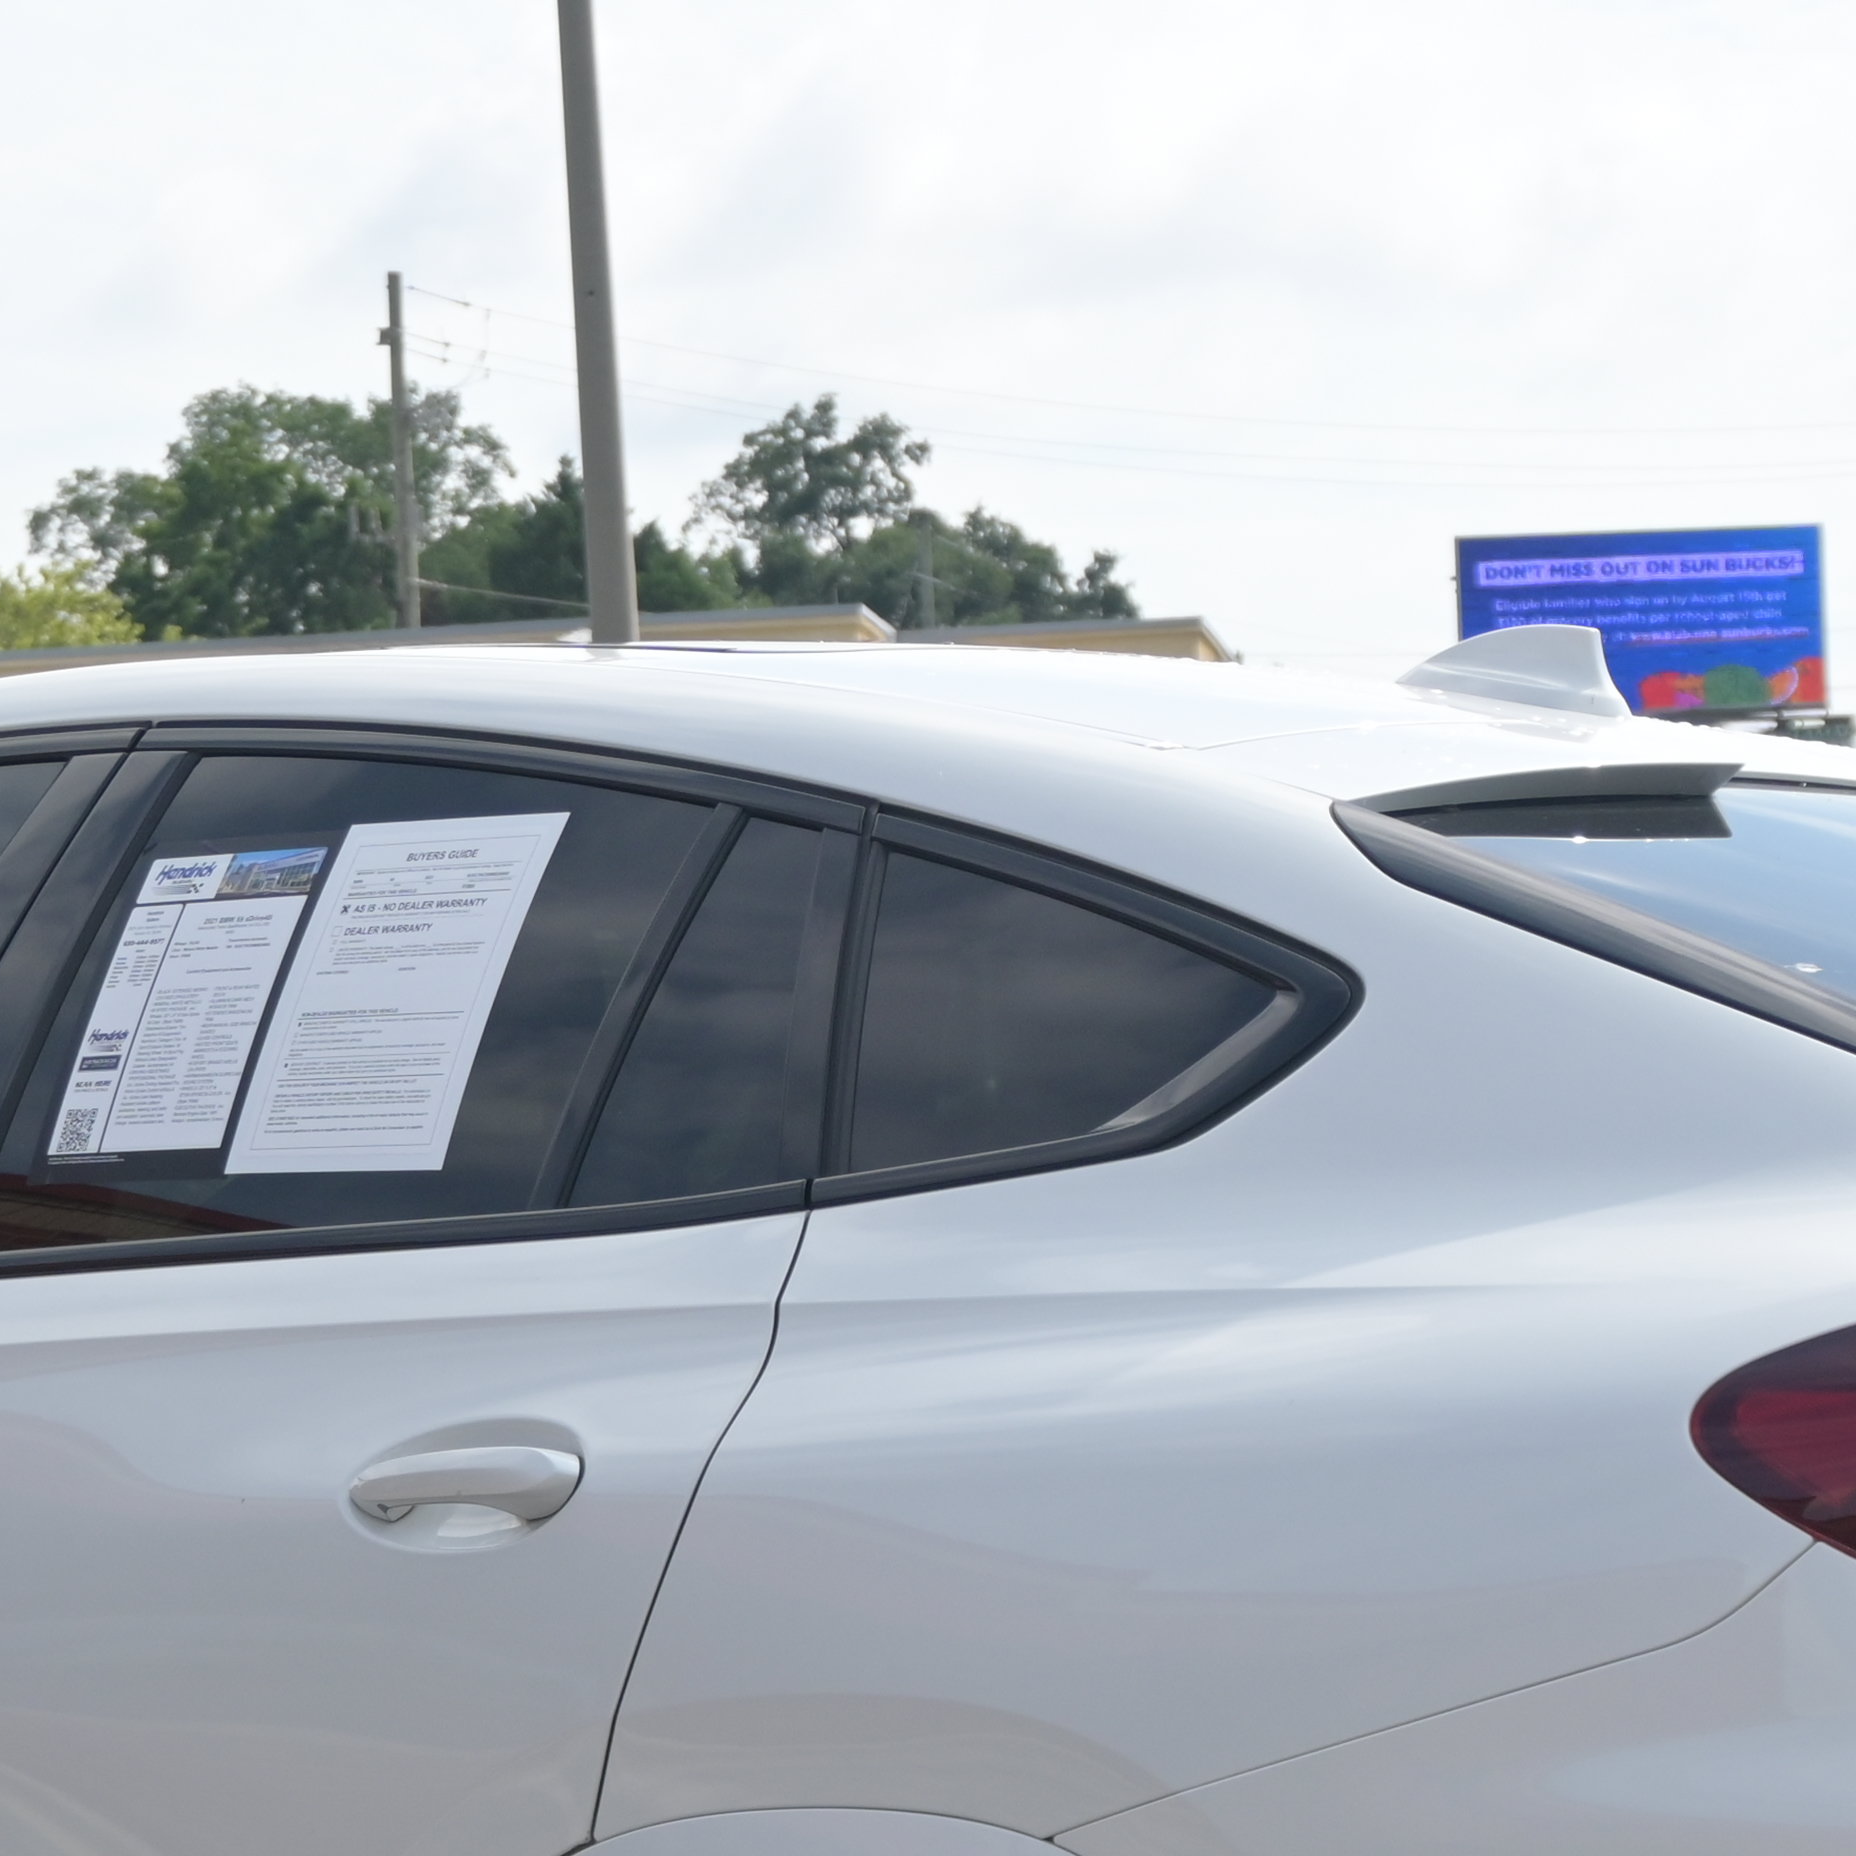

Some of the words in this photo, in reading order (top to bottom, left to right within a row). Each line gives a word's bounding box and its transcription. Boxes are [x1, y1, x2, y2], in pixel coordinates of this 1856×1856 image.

[1485, 565, 1542, 580] DON'T
[1550, 562, 1593, 577] MISS
[1601, 561, 1639, 576] OUT
[1646, 560, 1674, 573] ON
[1680, 559, 1719, 573] SUN
[1545, 597, 1591, 609] families
[1596, 597, 1621, 607] who
[1597, 612, 1646, 625] benefits
[1650, 612, 1671, 625] per
[406, 850, 446, 862] BUYERS
[448, 849, 480, 860] GUIDE
[354, 904, 366, 914] AS
[383, 902, 396, 912] NO
[398, 900, 434, 911] DEALER
[435, 898, 488, 909] WARRANTY
[344, 925, 380, 937] DEALER
[381, 923, 433, 935] WARRANTY
